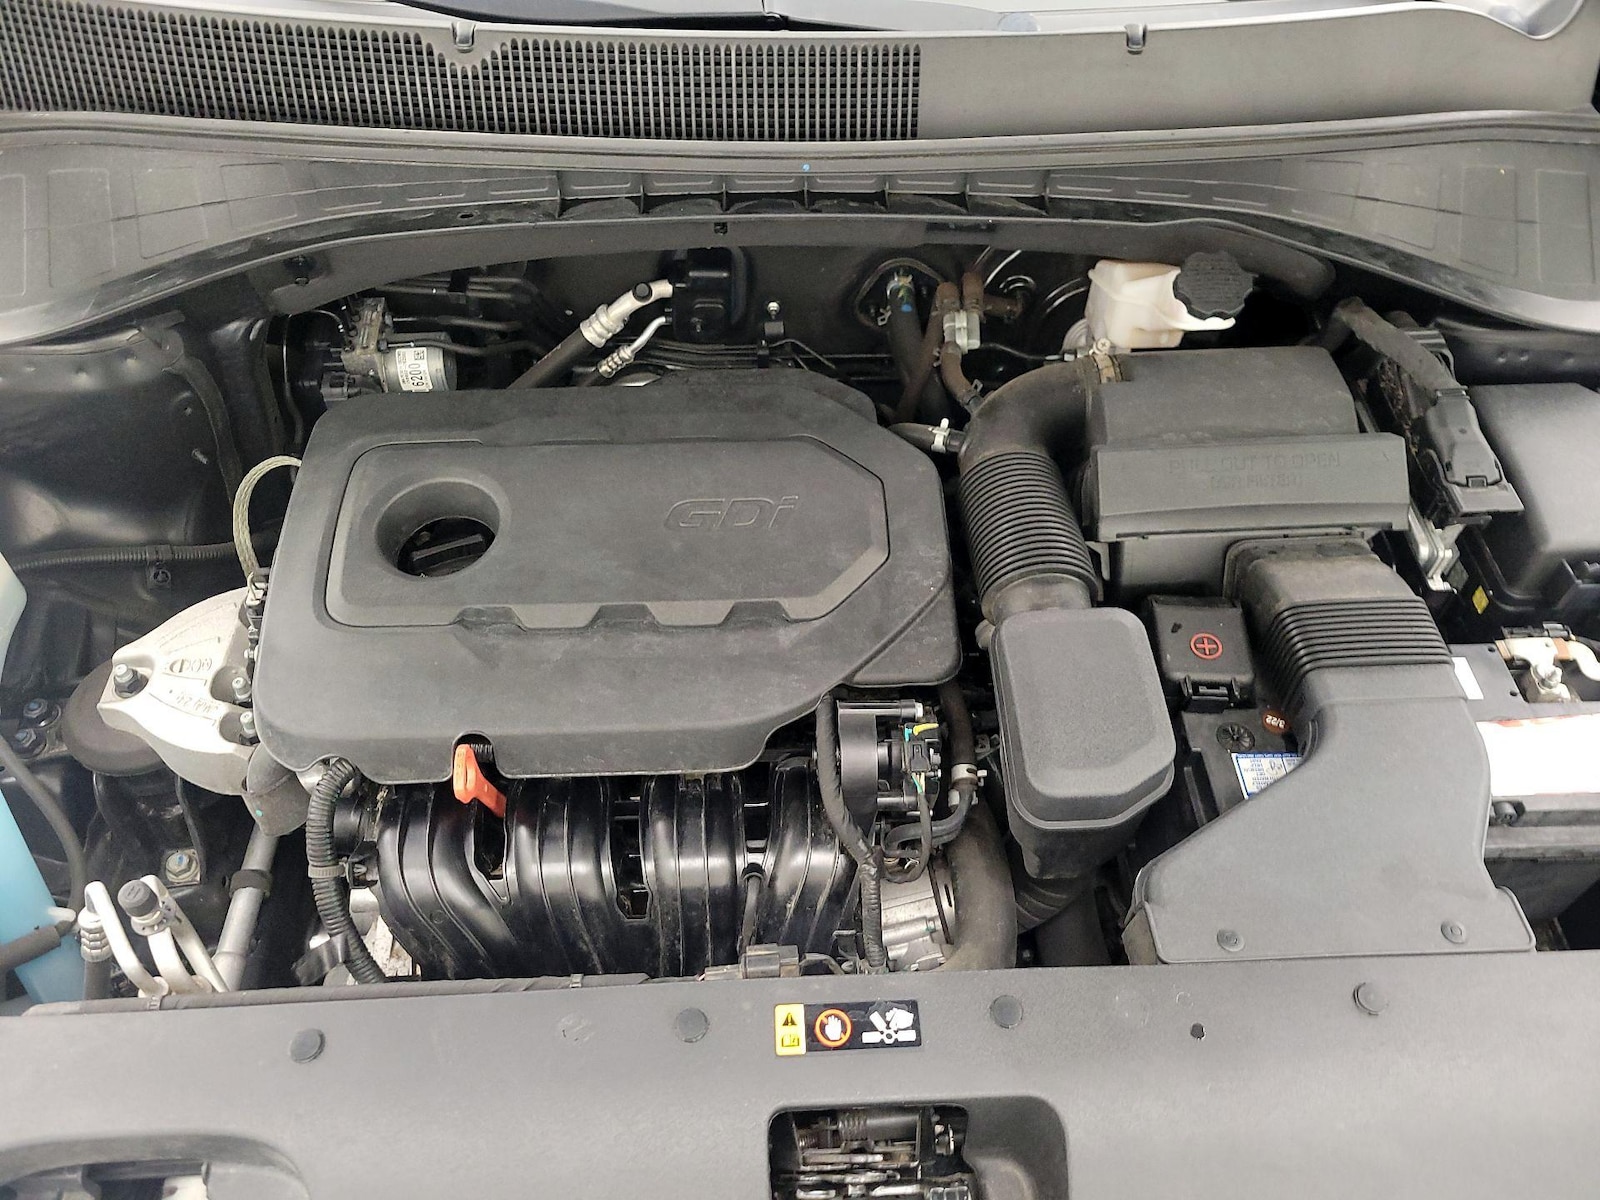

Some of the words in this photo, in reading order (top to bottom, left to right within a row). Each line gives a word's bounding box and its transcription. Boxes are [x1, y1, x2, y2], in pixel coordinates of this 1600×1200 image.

[408, 363, 425, 387] 6200
[1169, 457, 1216, 474] PULL
[1221, 455, 1256, 472] OUT
[1262, 453, 1286, 470] TO
[1292, 451, 1341, 468] OPEN
[1265, 714, 1286, 729] 3/22
